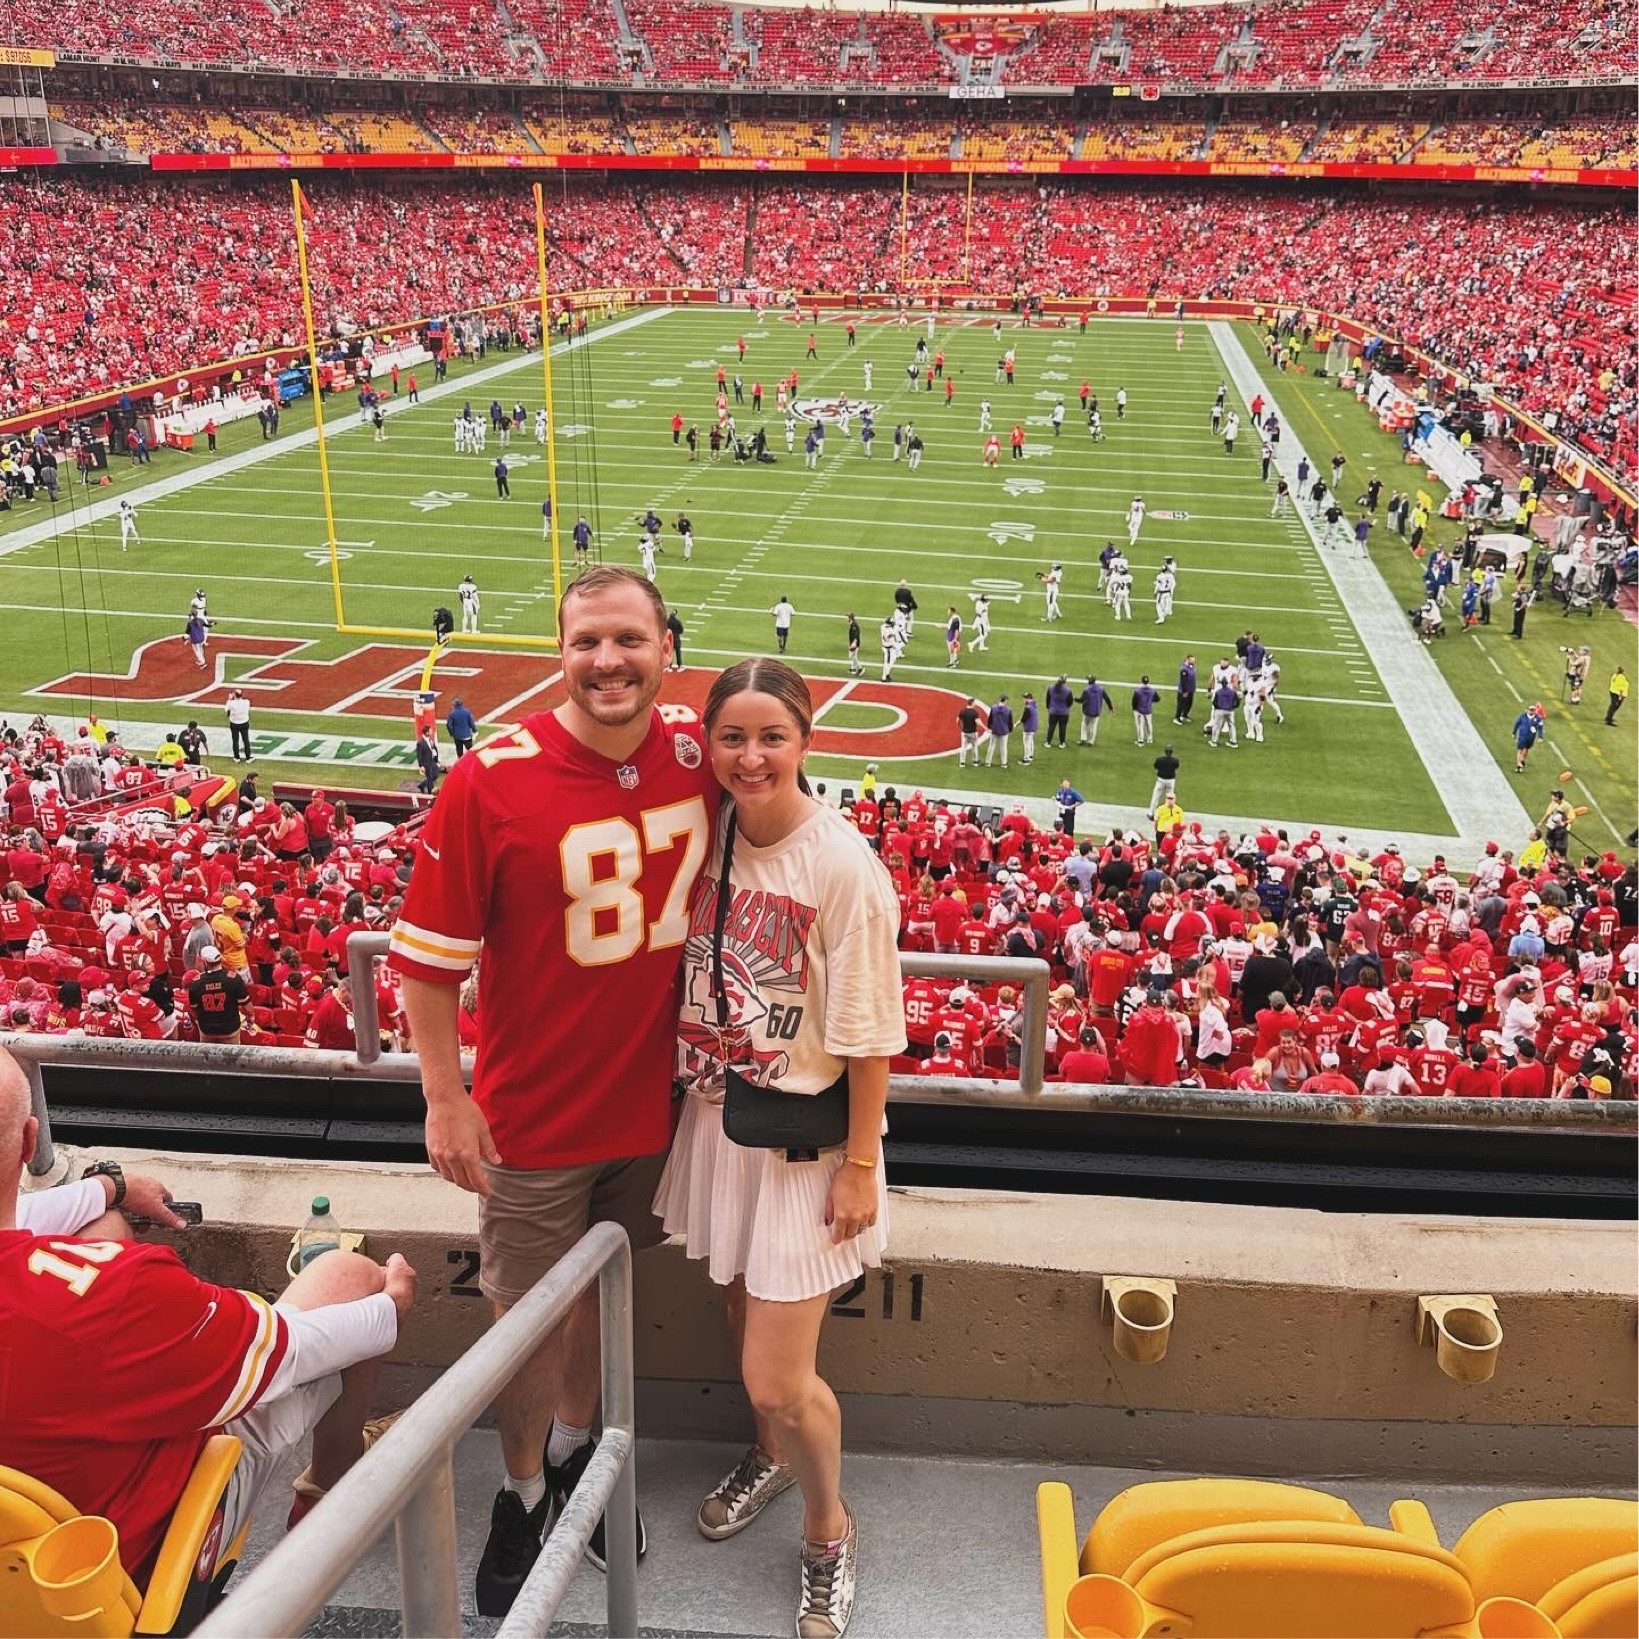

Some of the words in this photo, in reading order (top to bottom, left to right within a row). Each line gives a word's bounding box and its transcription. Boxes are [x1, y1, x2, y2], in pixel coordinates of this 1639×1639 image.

[957, 87, 996, 98] GEHA
[40, 813, 58, 833] 15
[859, 812, 873, 825] 17
[559, 796, 709, 968] 87
[1433, 889, 1454, 905] 58
[2, 908, 20, 924] 15
[167, 903, 188, 921] 15
[917, 903, 932, 915] 15
[1599, 922, 1613, 936] 10
[754, 892, 818, 994] CITY
[971, 938, 980, 954] 9
[765, 1002, 804, 1040] 60
[906, 1000, 930, 1025] 95
[1420, 1062, 1446, 1086] 13
[831, 1271, 924, 1321] 211
